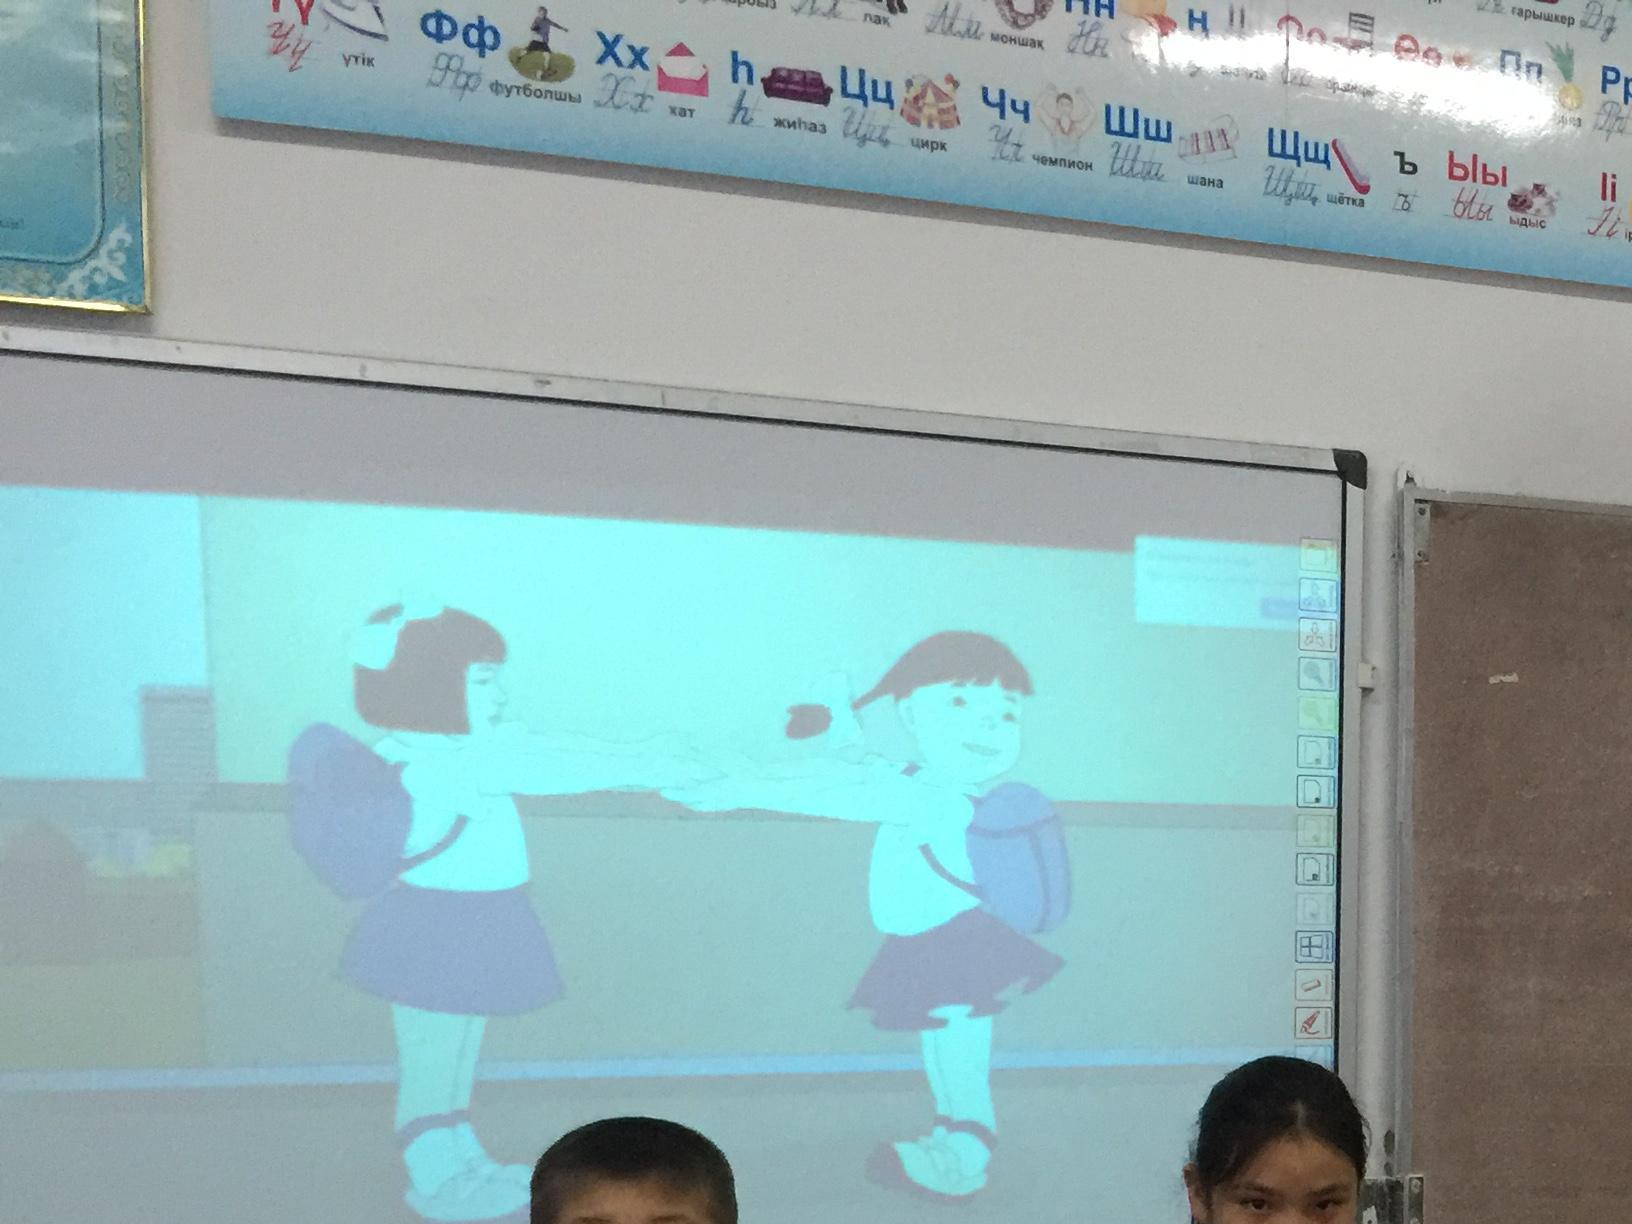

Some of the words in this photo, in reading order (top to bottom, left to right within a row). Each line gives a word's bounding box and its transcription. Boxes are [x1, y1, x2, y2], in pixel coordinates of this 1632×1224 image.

[420, 9, 501, 58] Фф
[990, 31, 1045, 50] моншақ
[596, 30, 650, 71] Хх
[489, 79, 582, 104] футболшы
[840, 65, 895, 110] Цц
[668, 104, 696, 118] хат
[981, 85, 1030, 124] Чч
[1105, 103, 1172, 143] Шш
[911, 137, 948, 153] цирк
[1268, 127, 1332, 171] Щщ
[1032, 152, 1093, 171] чемпион
[1448, 150, 1508, 187] Ыы
[1187, 174, 1224, 189] шана
[1326, 192, 1365, 208] щётка
[1509, 215, 1546, 229] ыдыс
